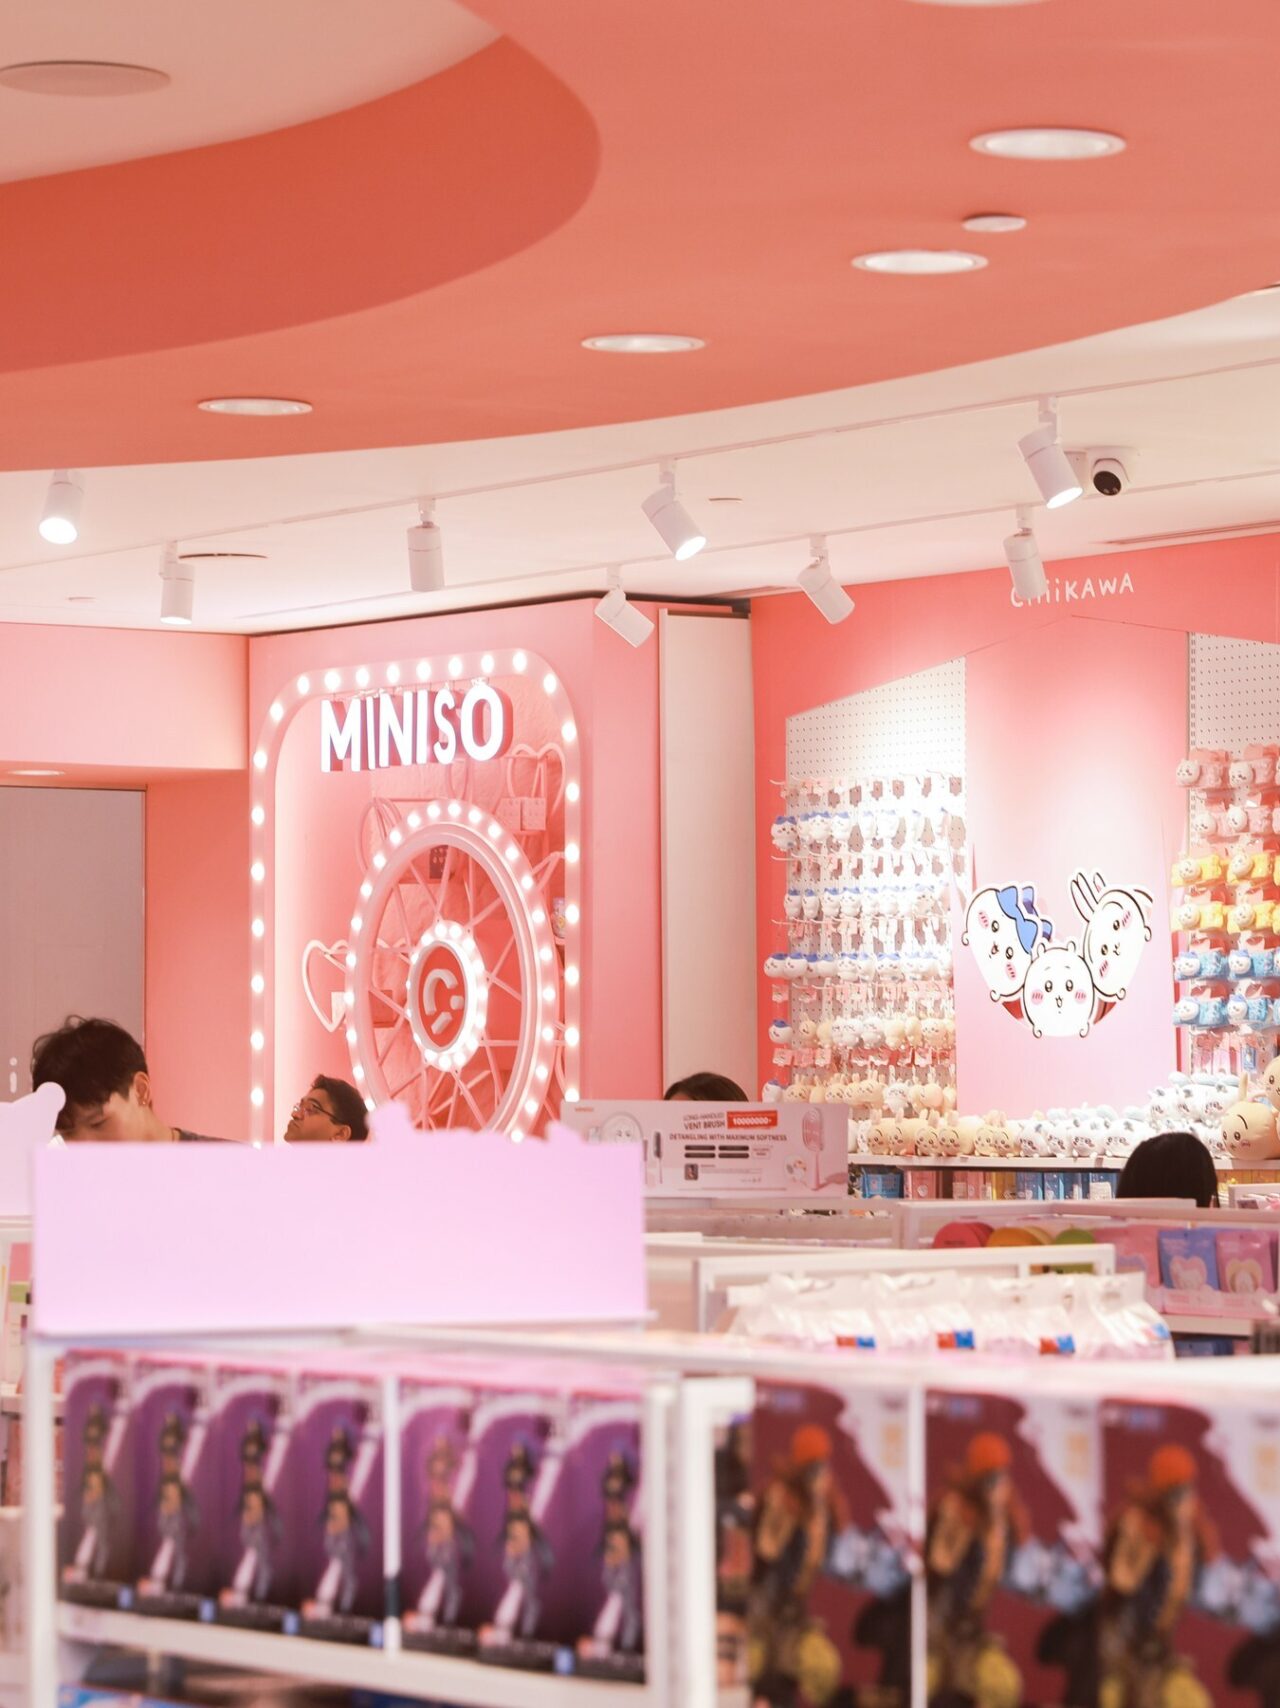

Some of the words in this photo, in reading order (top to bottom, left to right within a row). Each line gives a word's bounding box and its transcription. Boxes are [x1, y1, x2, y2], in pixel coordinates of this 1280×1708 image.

[320, 684, 507, 773] MINISO
[684, 1121, 702, 1130] VENT
[703, 1120, 725, 1129] BRUSH
[669, 1133, 708, 1141] DETANGLING
[726, 1133, 755, 1141] MAXIMUM
[756, 1133, 787, 1141] SOFTNESS
